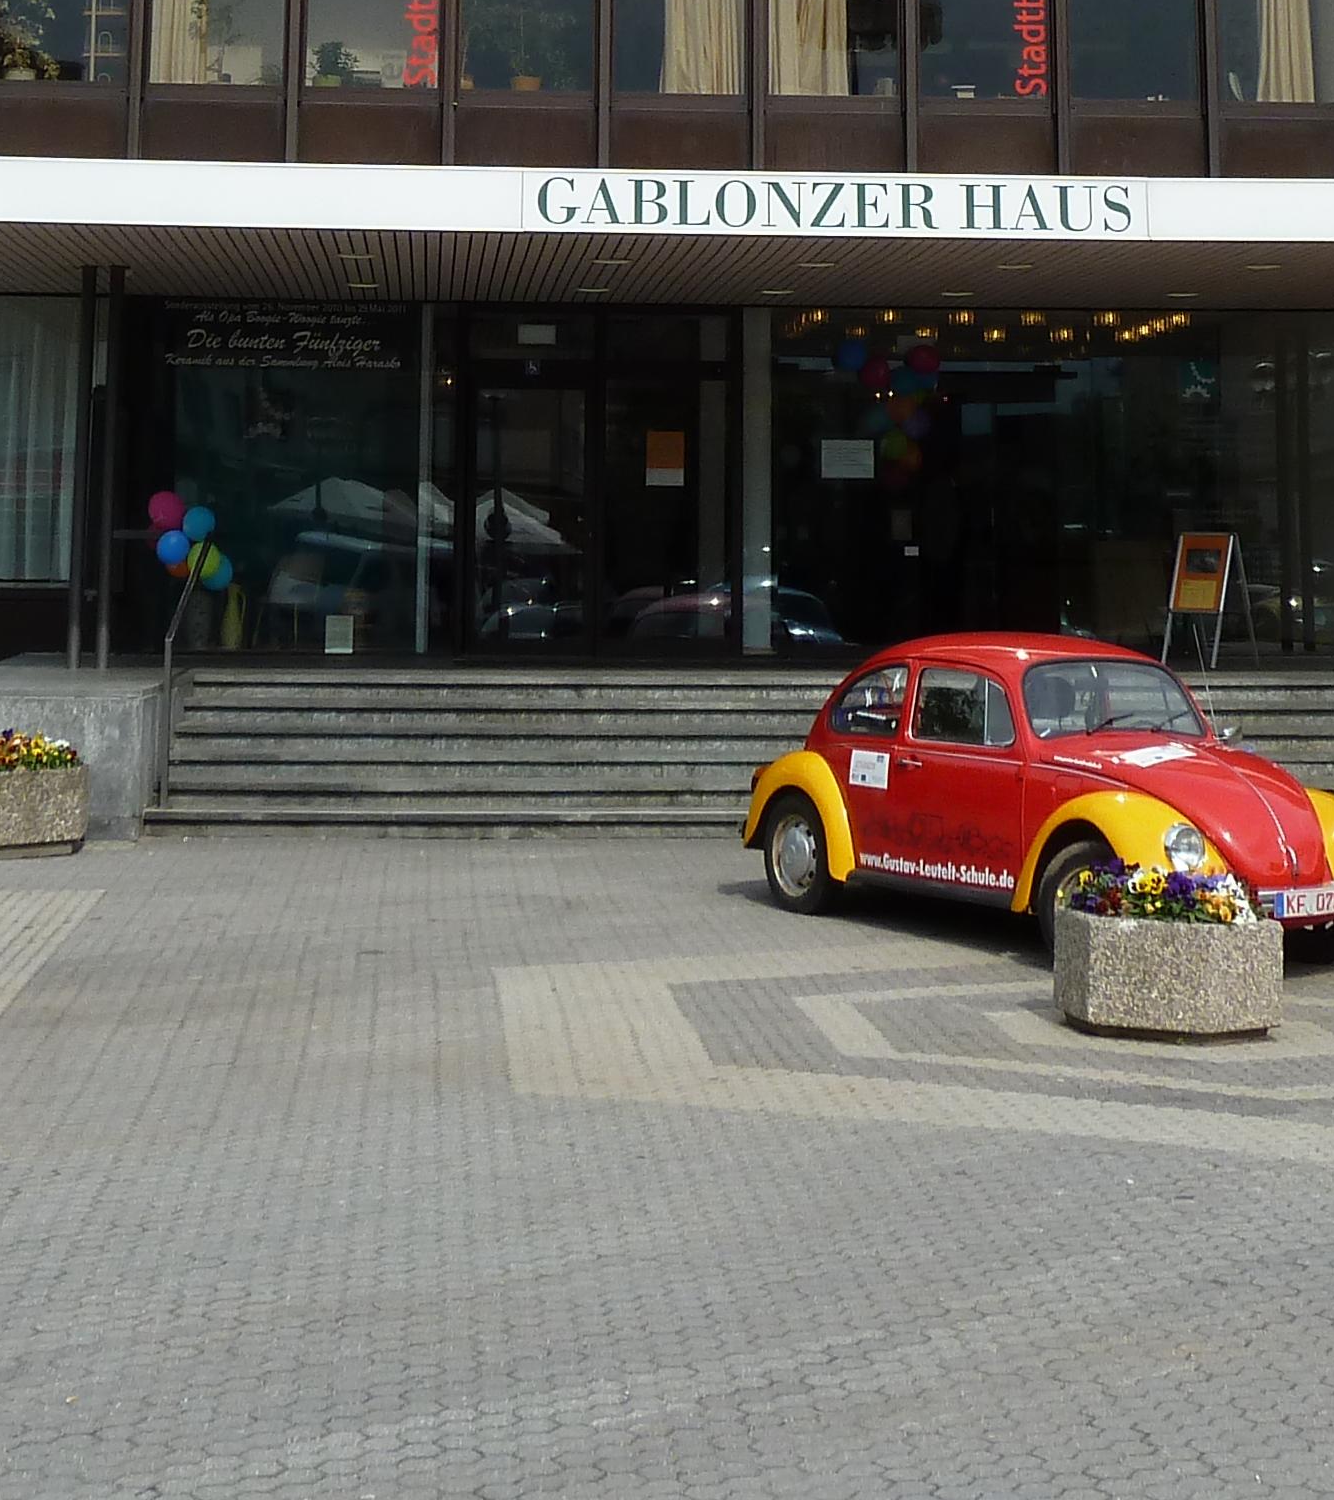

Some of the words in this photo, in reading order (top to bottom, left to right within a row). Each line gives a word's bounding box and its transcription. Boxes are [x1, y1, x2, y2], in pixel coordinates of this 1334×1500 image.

[537, 176, 940, 231] GABLONZER
[958, 183, 1133, 235] HAUS
[218, 310, 242, 324] Opa
[186, 328, 223, 349] Die
[227, 328, 286, 349] bunten
[292, 330, 382, 357] Fünfziger
[164, 352, 213, 366] Keramik
[214, 357, 235, 367] aus
[237, 355, 256, 367] der
[258, 354, 320, 370] Sammlung
[321, 355, 352, 368] Alois
[859, 852, 1015, 889] www.Gustav-Leutelt-Schule.de
[1286, 894, 1307, 915] KF
